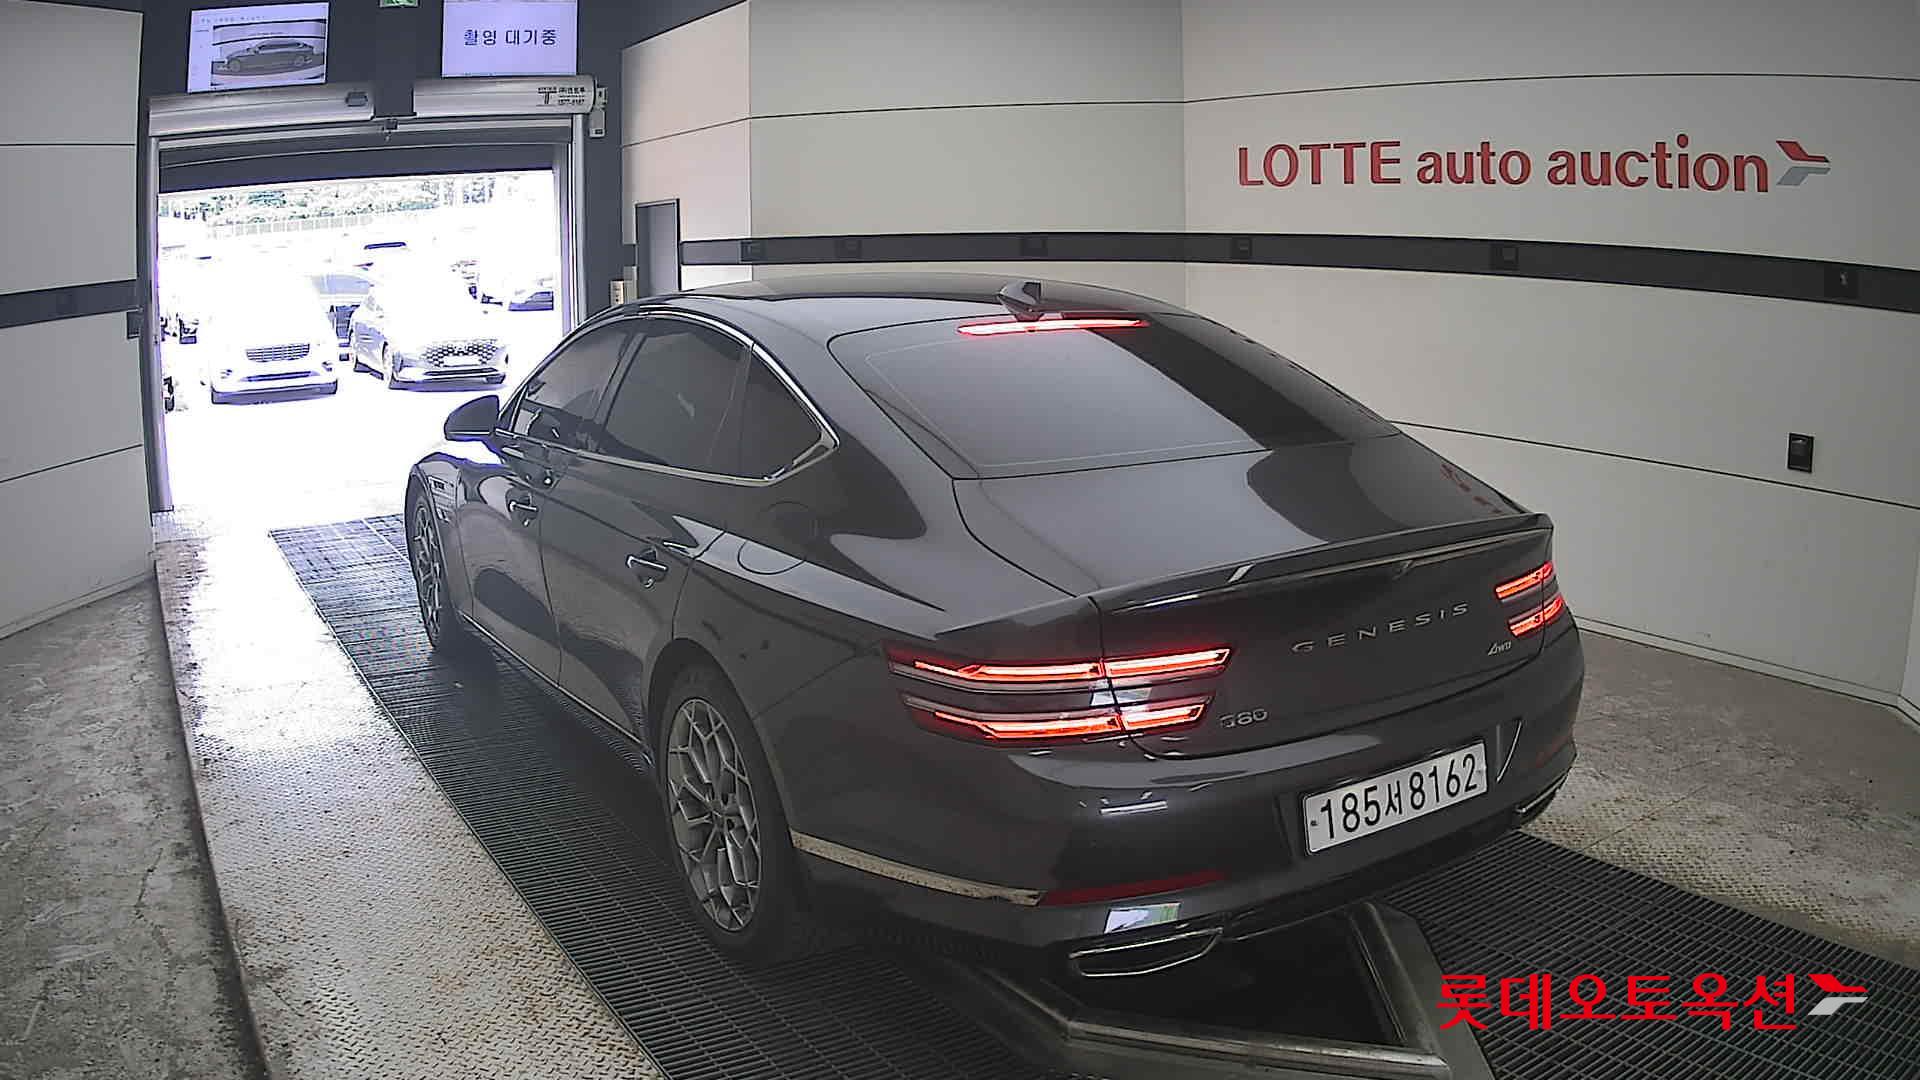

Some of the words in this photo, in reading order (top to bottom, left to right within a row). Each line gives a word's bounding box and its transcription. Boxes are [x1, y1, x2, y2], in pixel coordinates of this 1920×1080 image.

[505, 29, 557, 46] 대기중
[1238, 140, 1402, 186] LOTTE
[1417, 141, 1531, 185] auto
[1548, 134, 1768, 193] auction
[1291, 602, 1469, 653] GENESIS
[1320, 753, 1478, 839] 185서8162
